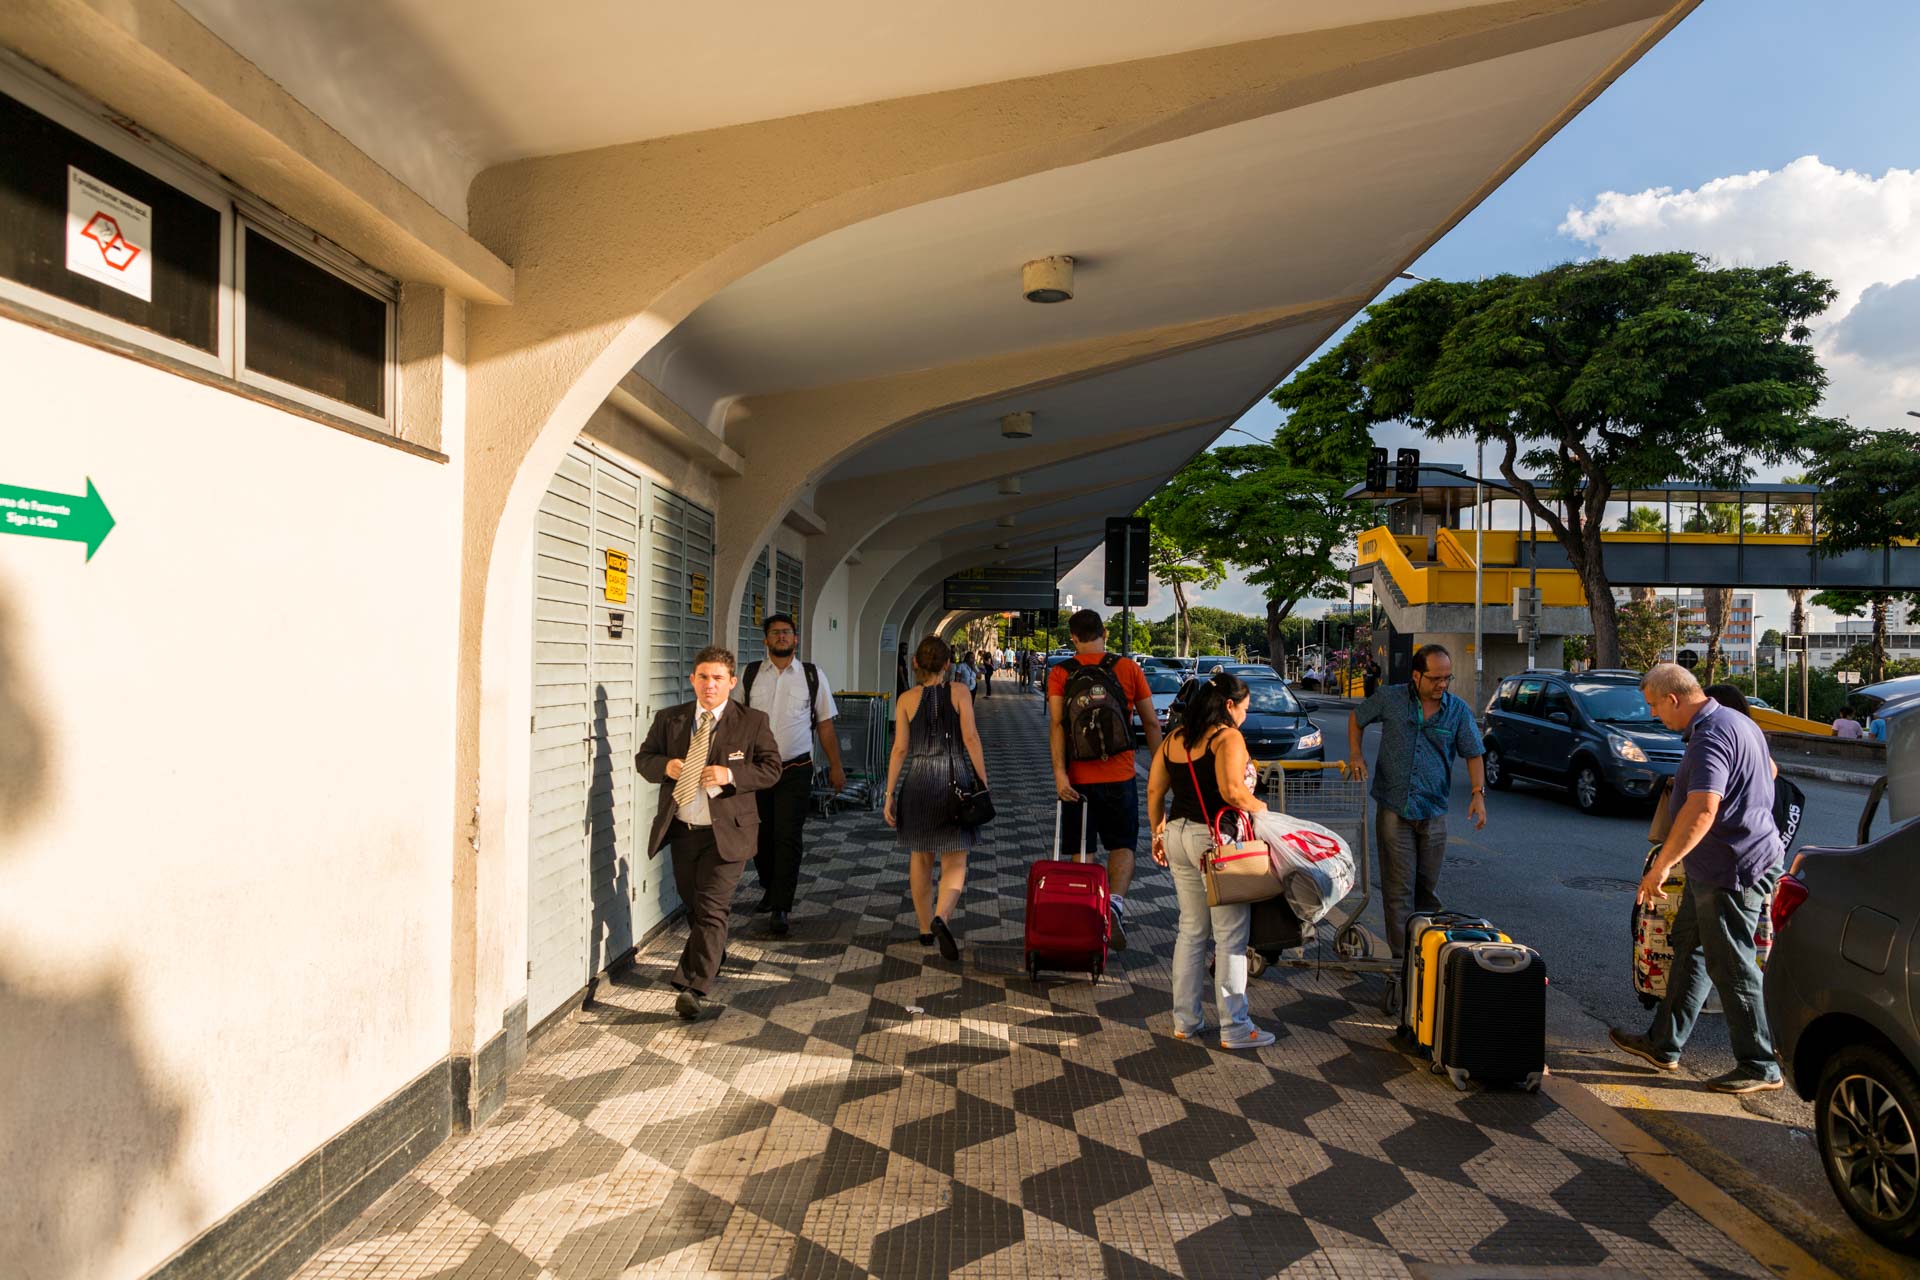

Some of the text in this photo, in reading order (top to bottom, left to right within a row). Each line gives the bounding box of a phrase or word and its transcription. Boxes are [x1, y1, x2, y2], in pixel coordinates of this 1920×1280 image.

[6, 511, 58, 529] Siga a Seta
[1780, 803, 1801, 849] didas
